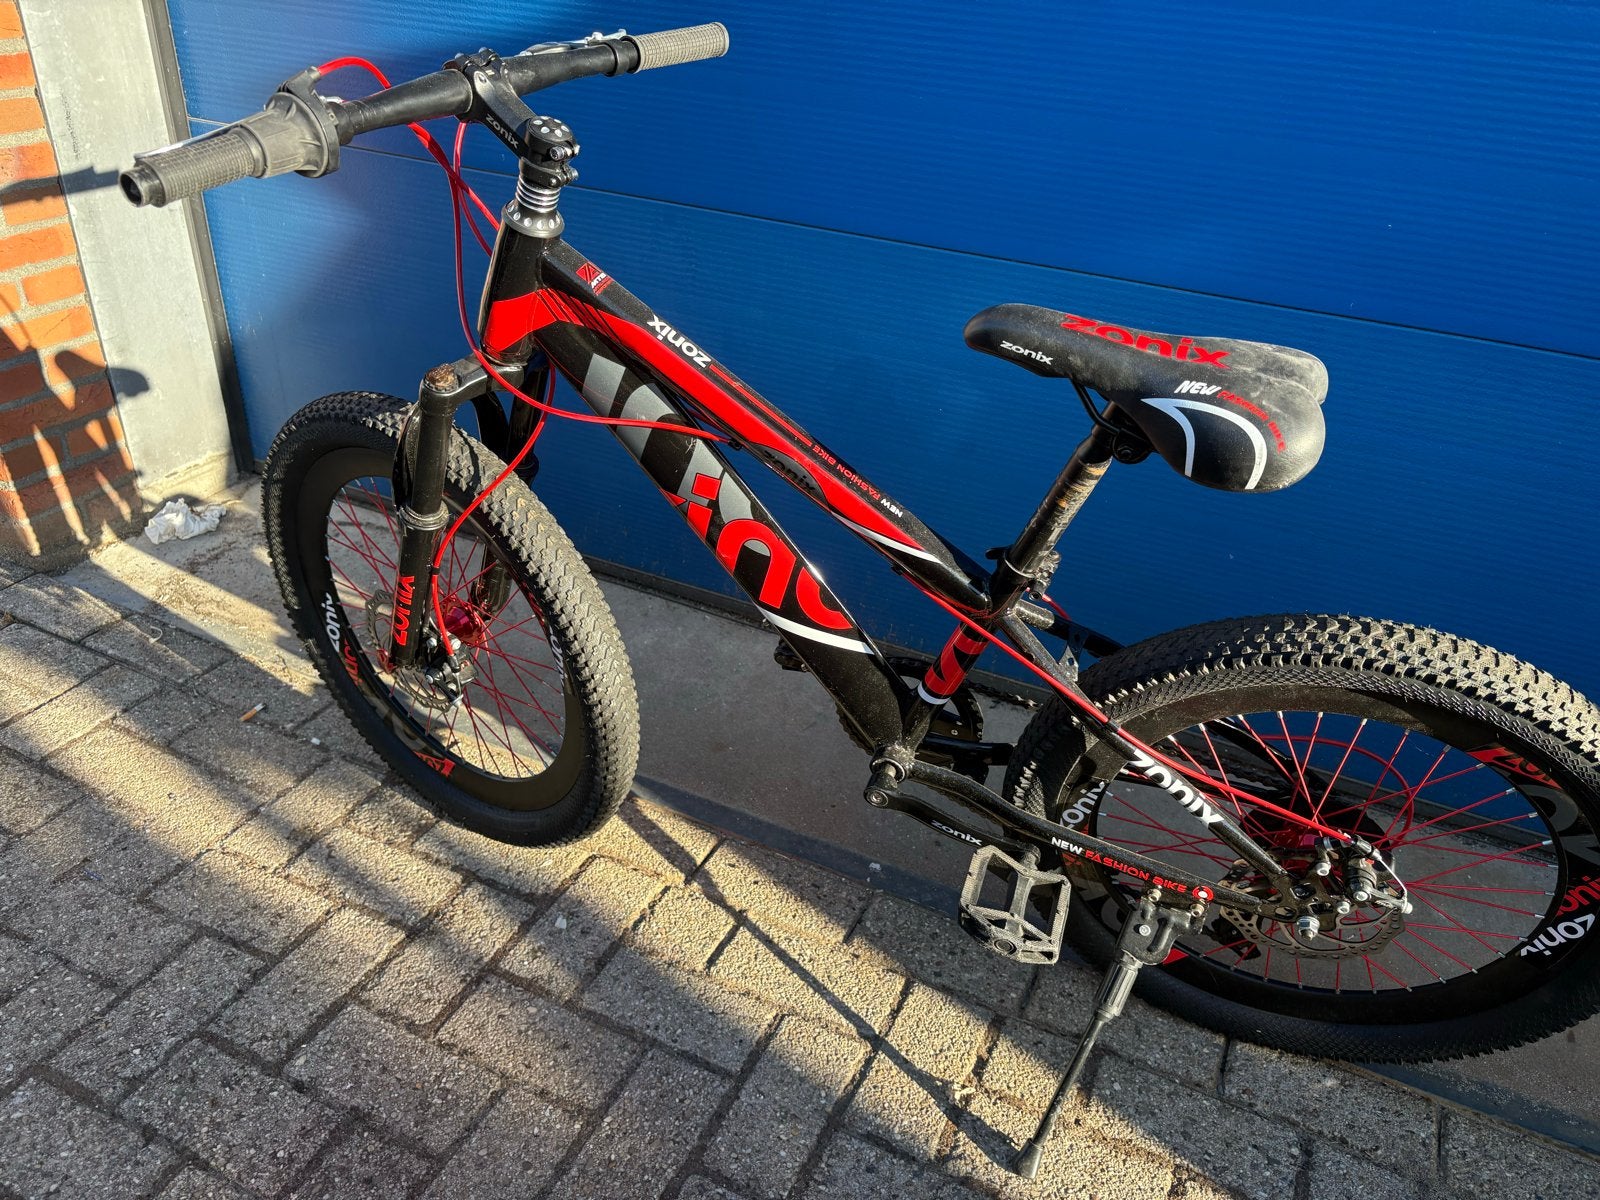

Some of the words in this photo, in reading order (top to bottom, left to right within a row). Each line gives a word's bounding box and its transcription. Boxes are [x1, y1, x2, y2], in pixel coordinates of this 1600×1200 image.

[485, 113, 519, 149] zonix
[647, 314, 712, 369] zonix
[999, 339, 1052, 366] zonix
[1060, 313, 1231, 370] zonix
[1174, 380, 1222, 396] NEW
[812, 443, 838, 466] BIKE
[835, 463, 881, 501] FASHION
[880, 497, 904, 518] NEW
[930, 819, 983, 847] zonix
[1051, 836, 1083, 855] NEW
[1083, 849, 1151, 880] FASHION
[1152, 875, 1188, 893] BIKE
